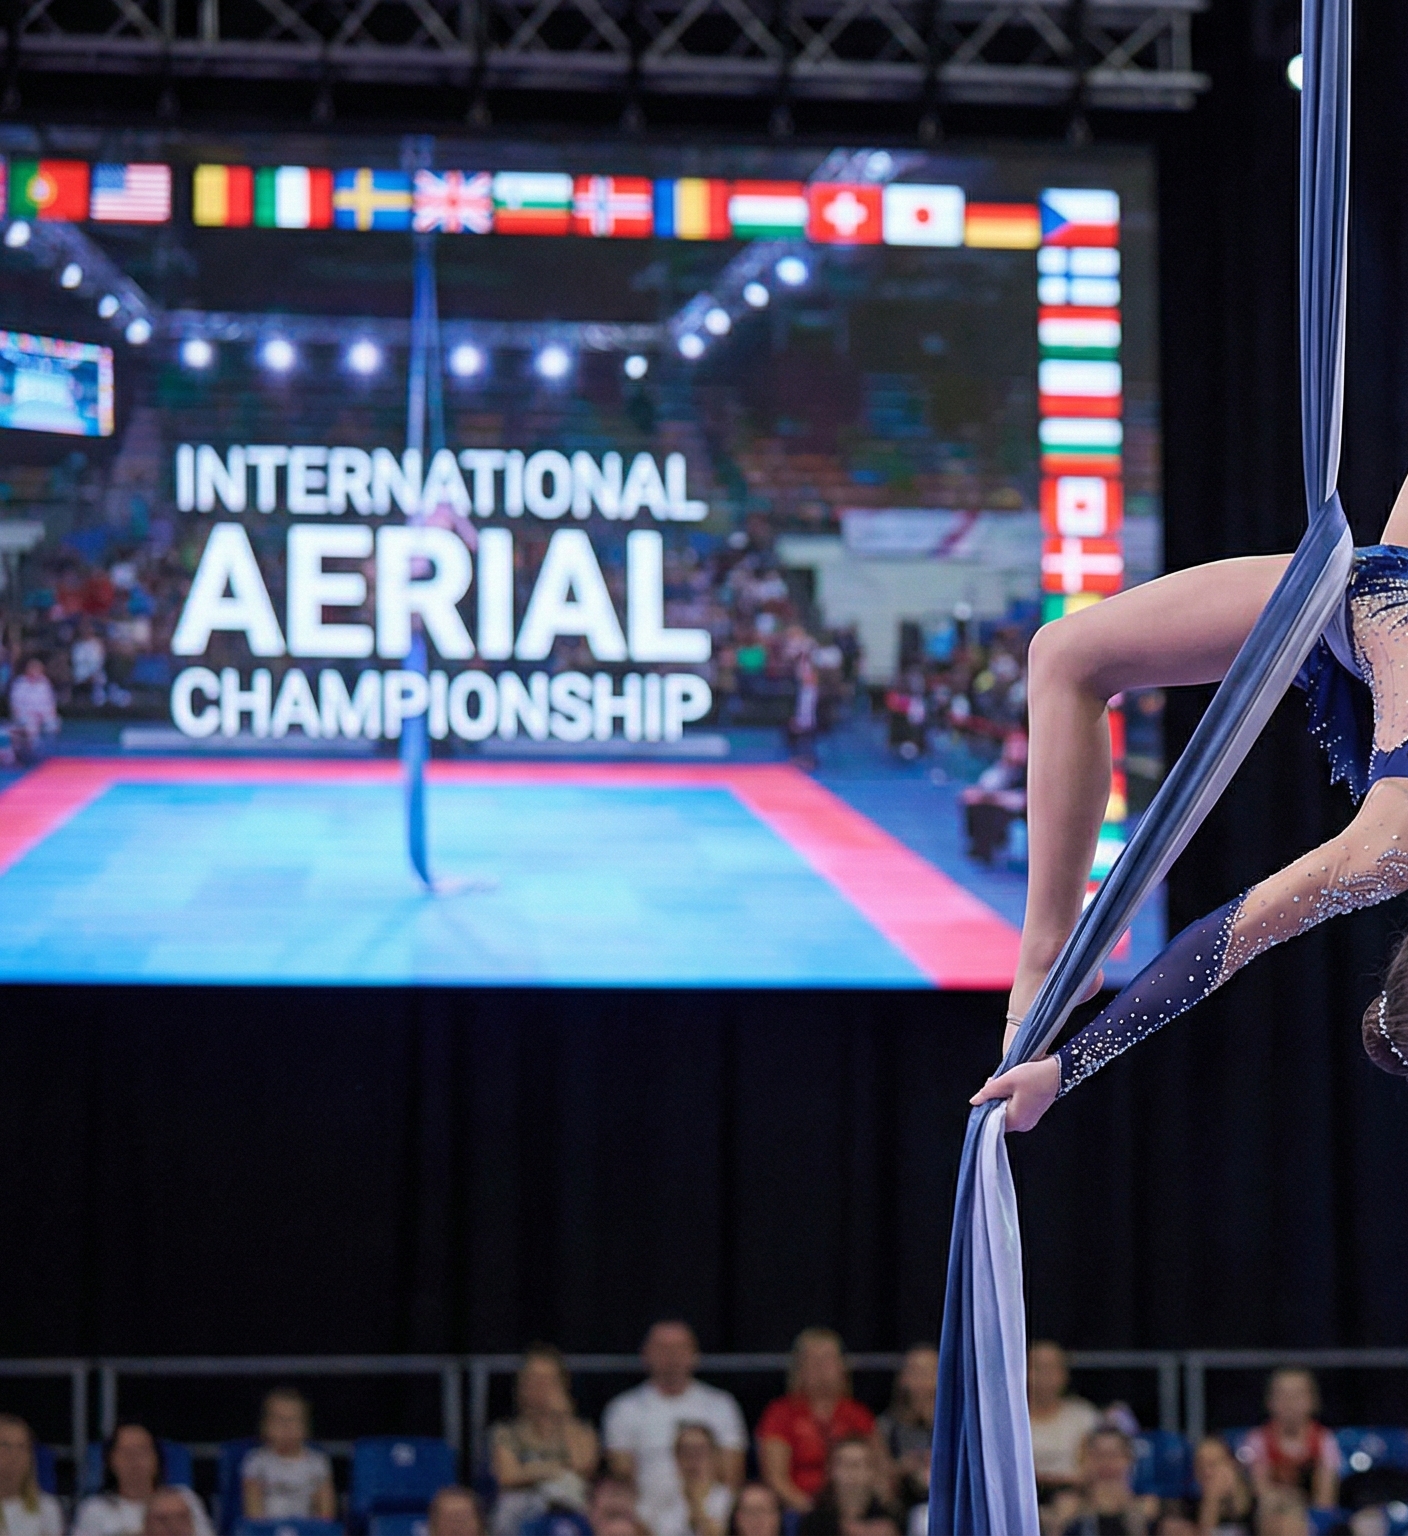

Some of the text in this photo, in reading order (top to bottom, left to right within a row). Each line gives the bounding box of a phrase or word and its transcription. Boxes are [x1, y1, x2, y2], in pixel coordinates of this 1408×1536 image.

[177, 444, 708, 520] INTERNATIONAL
[172, 523, 712, 662] AERIAL
[171, 667, 712, 741] CHAMPIONSHIP
